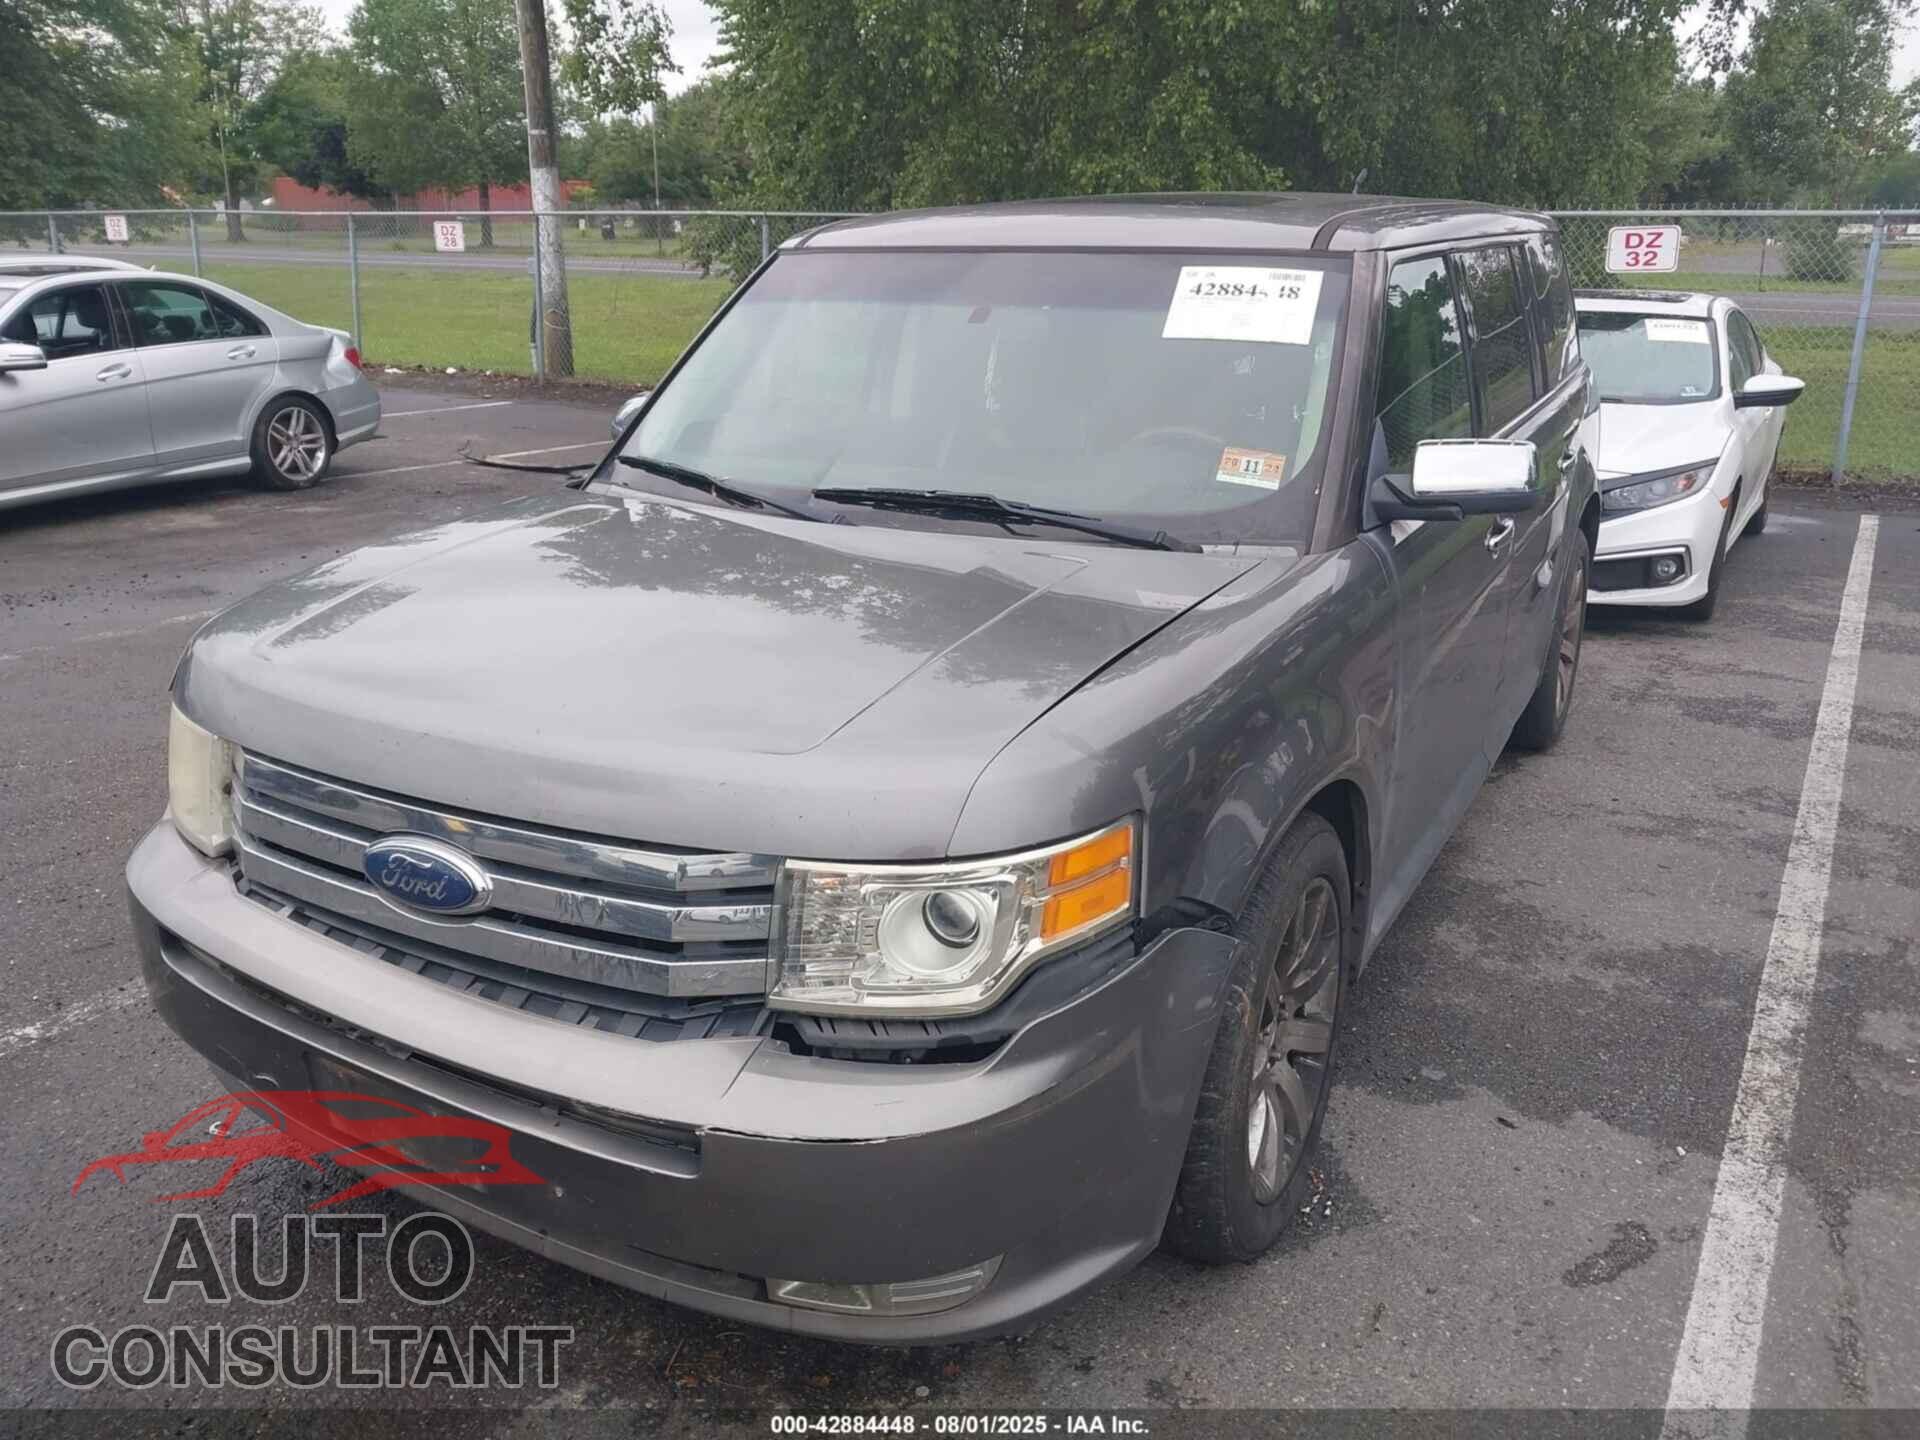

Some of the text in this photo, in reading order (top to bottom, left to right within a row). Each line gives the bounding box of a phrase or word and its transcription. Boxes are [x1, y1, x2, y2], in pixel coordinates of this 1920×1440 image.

[440, 225, 456, 237] DZ
[443, 236, 457, 248] 28
[1624, 232, 1664, 249] DZ
[1625, 251, 1658, 267] 32
[1243, 459, 1259, 474] 11
[382, 853, 448, 901] Ford
